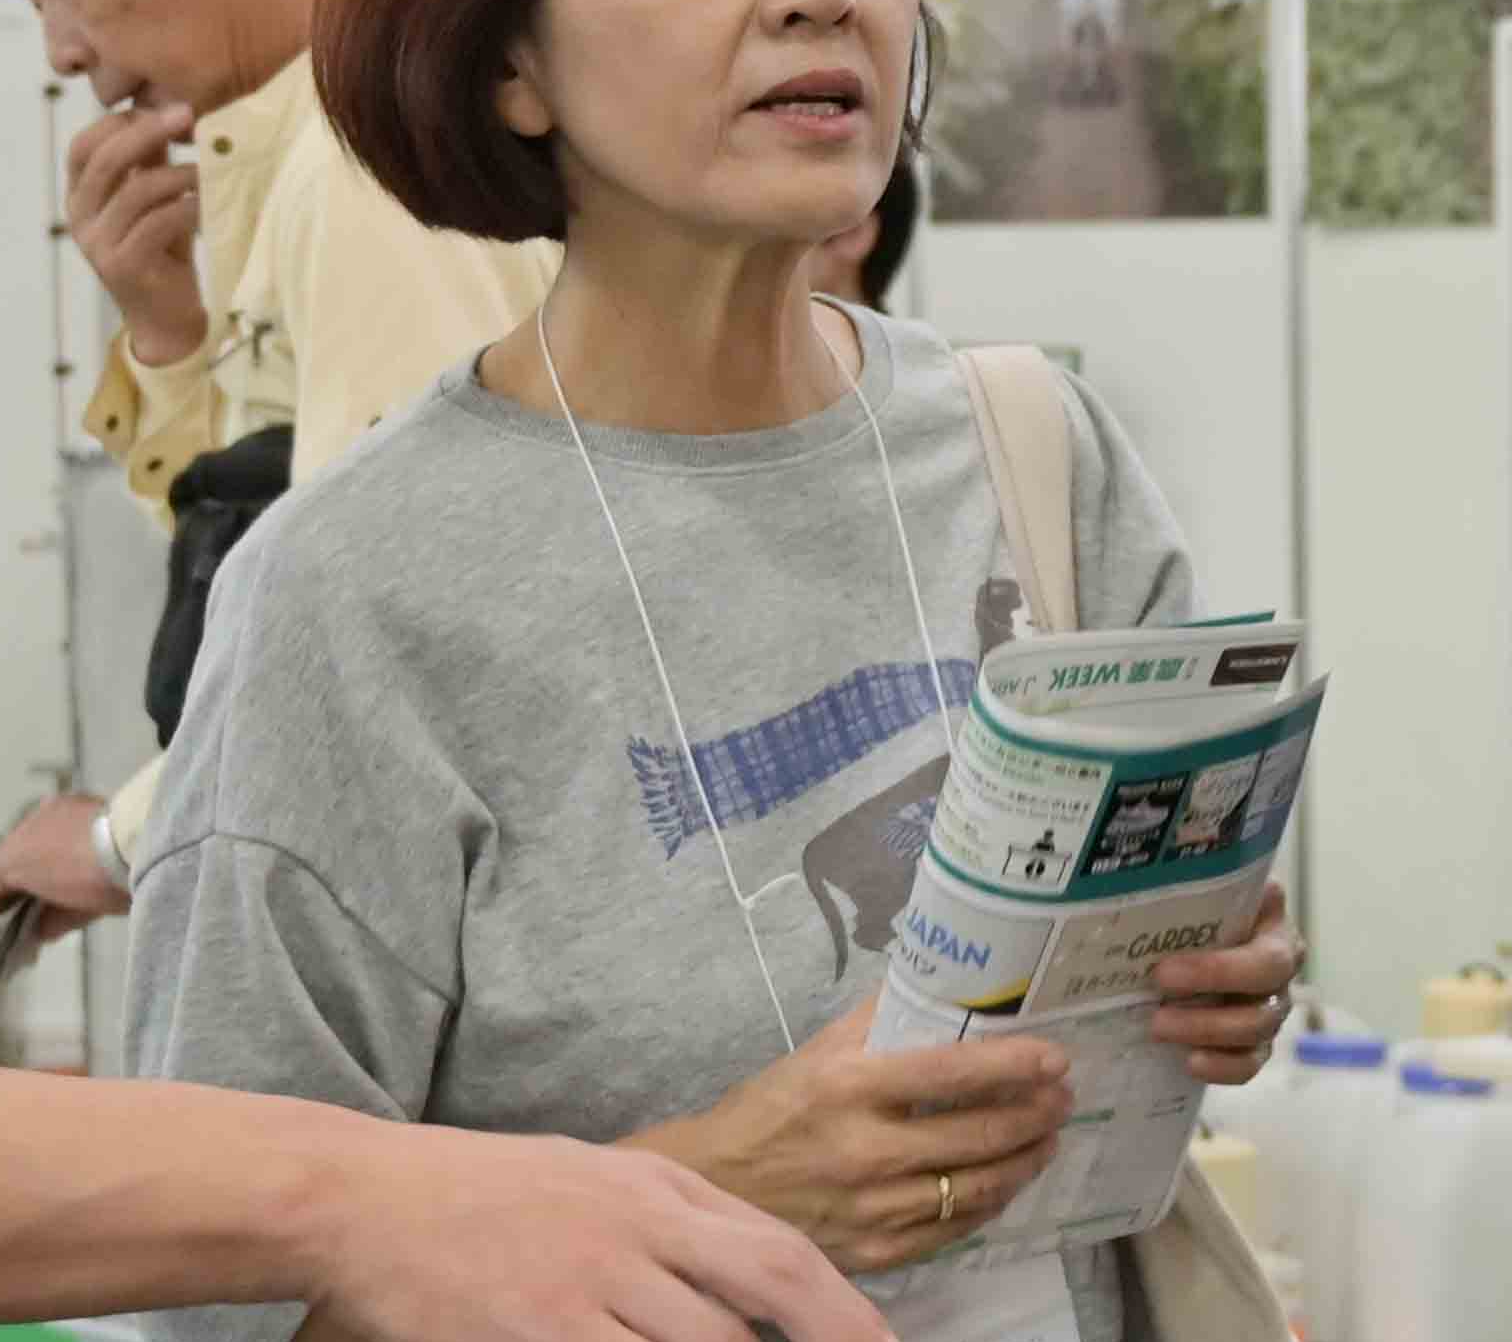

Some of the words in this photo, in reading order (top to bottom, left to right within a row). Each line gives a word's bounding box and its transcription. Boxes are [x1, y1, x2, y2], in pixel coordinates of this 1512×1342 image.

[1048, 662, 1120, 691] WEEK
[906, 909, 991, 970] JAPAN
[1127, 921, 1223, 960] GARDEX
